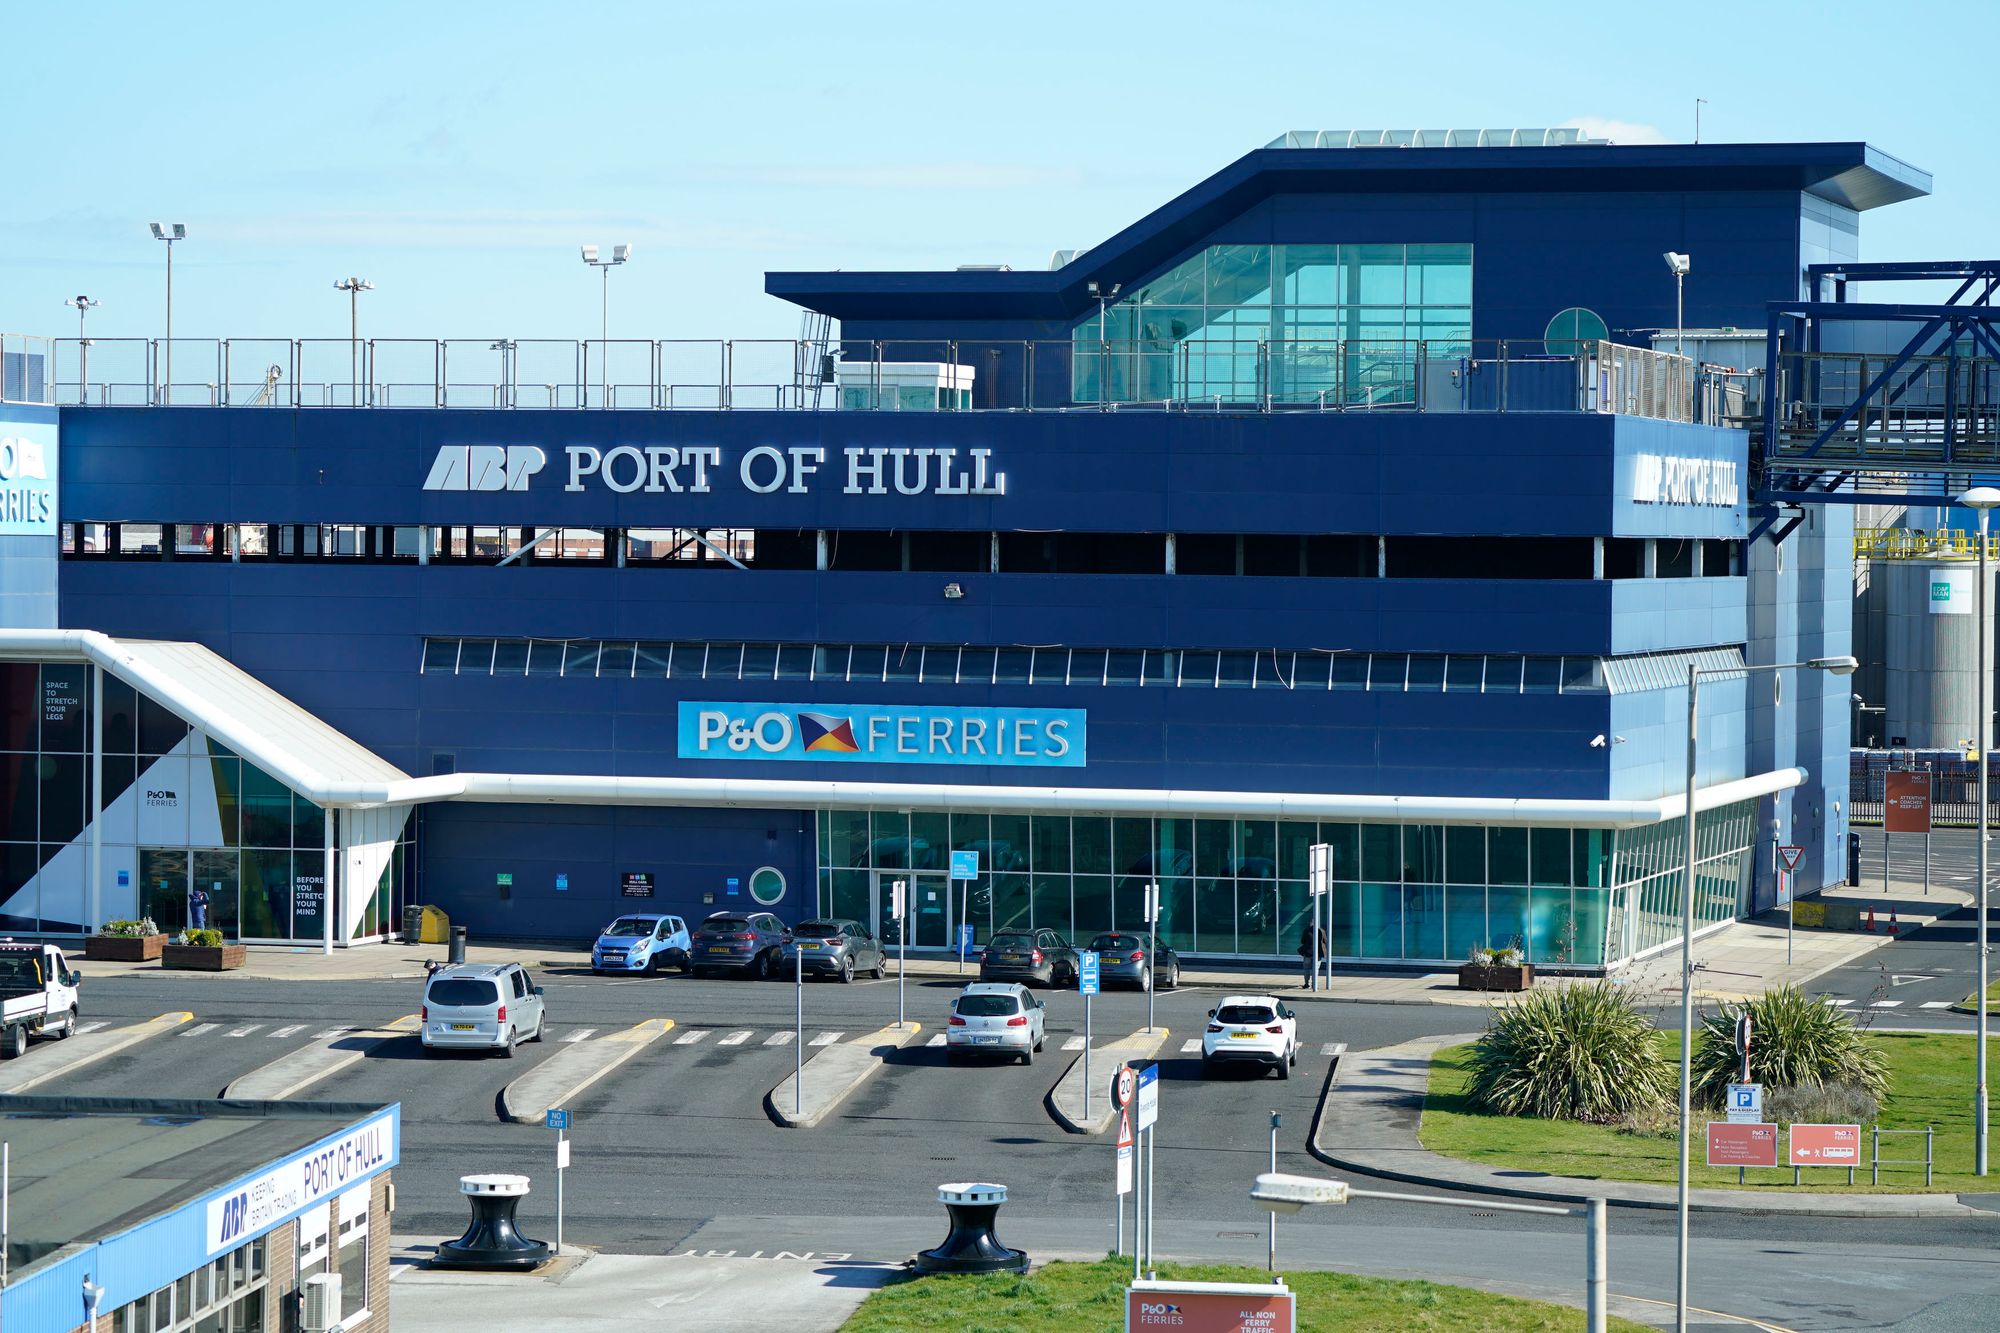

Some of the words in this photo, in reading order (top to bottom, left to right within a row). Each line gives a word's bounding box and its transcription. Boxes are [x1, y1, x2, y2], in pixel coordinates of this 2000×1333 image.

[422, 444, 546, 491] ABP
[565, 445, 719, 493] PORT
[740, 446, 825, 494] OF
[843, 447, 1005, 495] HULL
[1665, 456, 1694, 504] PORT
[1694, 458, 1711, 505] OF
[1712, 460, 1738, 506] HULL
[699, 711, 793, 753] P&O
[868, 716, 1069, 758] FERRIES
[147, 790, 165, 799] P&O
[146, 799, 178, 807] FERRIES
[1120, 1078, 1131, 1095] 20
[304, 1149, 335, 1200] PORT
[338, 1140, 352, 1182] OF
[355, 1127, 383, 1174] HULL
[1141, 1303, 1166, 1315] P&O
[1141, 1314, 1184, 1325] FERRIES
[1239, 1311, 1254, 1319] ALL
[1256, 1312, 1276, 1320] NON
[1244, 1319, 1271, 1327] FERRY
